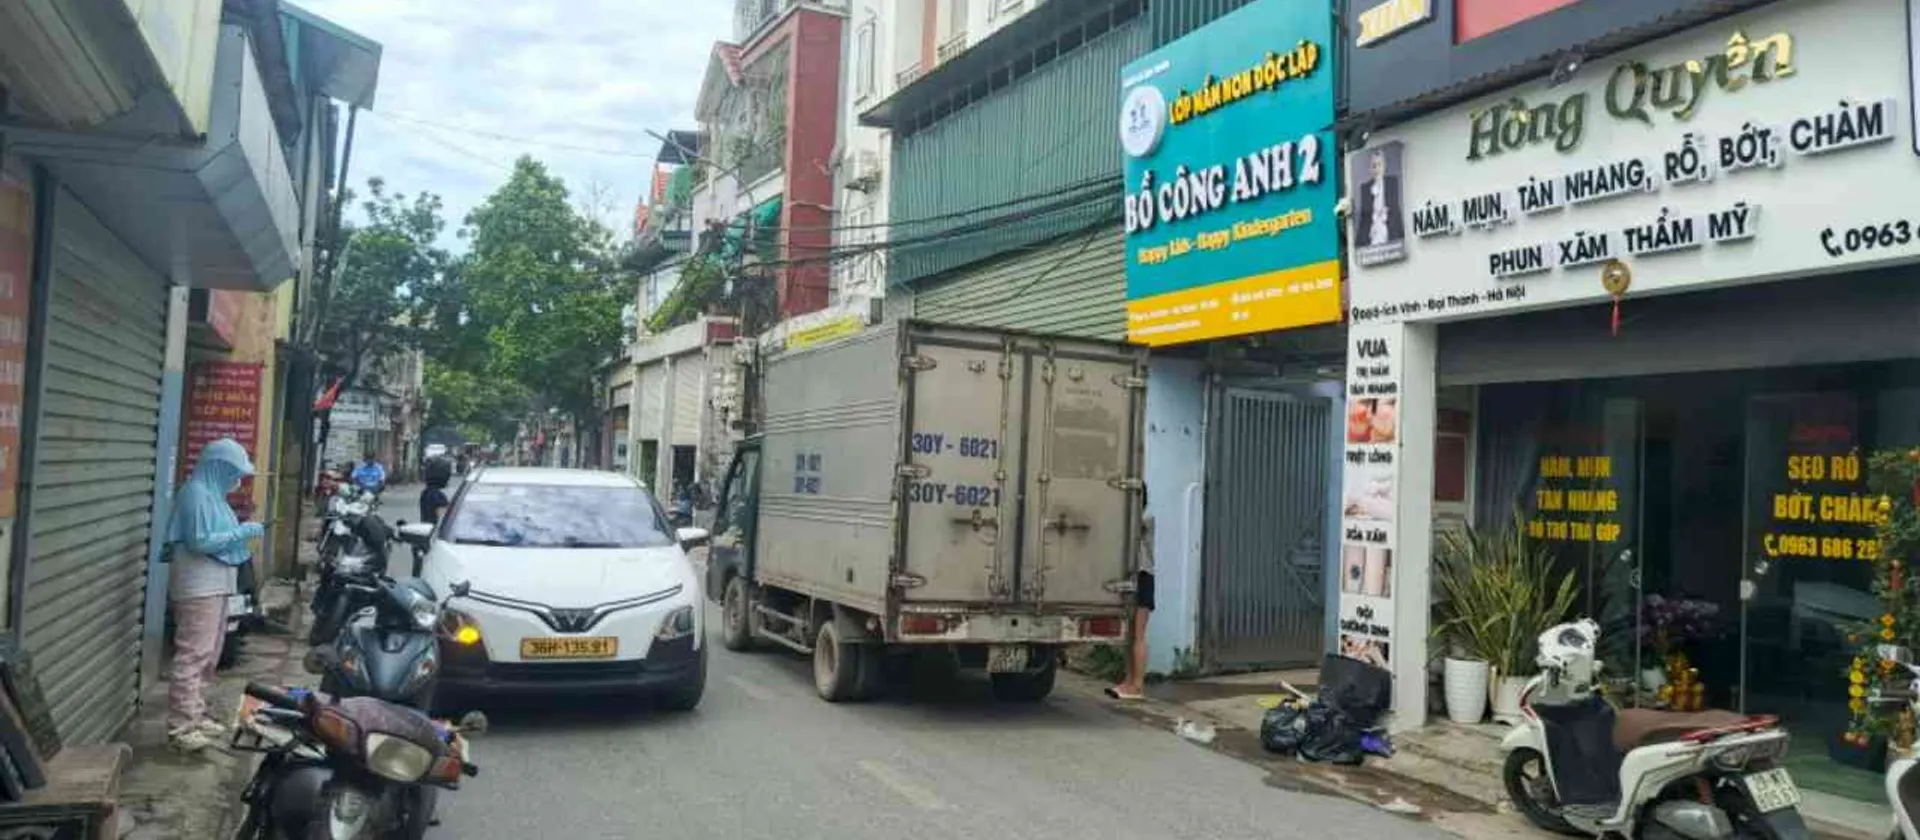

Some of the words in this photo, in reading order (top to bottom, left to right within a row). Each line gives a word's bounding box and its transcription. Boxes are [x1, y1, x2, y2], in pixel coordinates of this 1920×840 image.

[1222, 69, 1251, 103] NON
[1466, 92, 1588, 160] Hồng
[1605, 30, 1796, 127] Quyên
[1158, 165, 1225, 223] CÔNG
[1231, 141, 1293, 203] ANH
[1298, 134, 1320, 185] 2
[1413, 200, 1454, 234] NÁM,
[1518, 176, 1554, 211] TÀN
[1565, 159, 1652, 201] NHANG,
[1719, 122, 1776, 168] BỚT,
[1790, 100, 1884, 151] CHÀM
[1490, 246, 1542, 275] PHUN
[1559, 231, 1608, 265] XĂM
[1624, 207, 1693, 253] THẨM
[1709, 201, 1749, 240] MỸ
[1845, 220, 1911, 252] 0963
[1357, 338, 1388, 358] VUA
[912, 433, 944, 455] 30Y
[960, 436, 998, 459] 6021
[910, 482, 1000, 507] 30Y-6021
